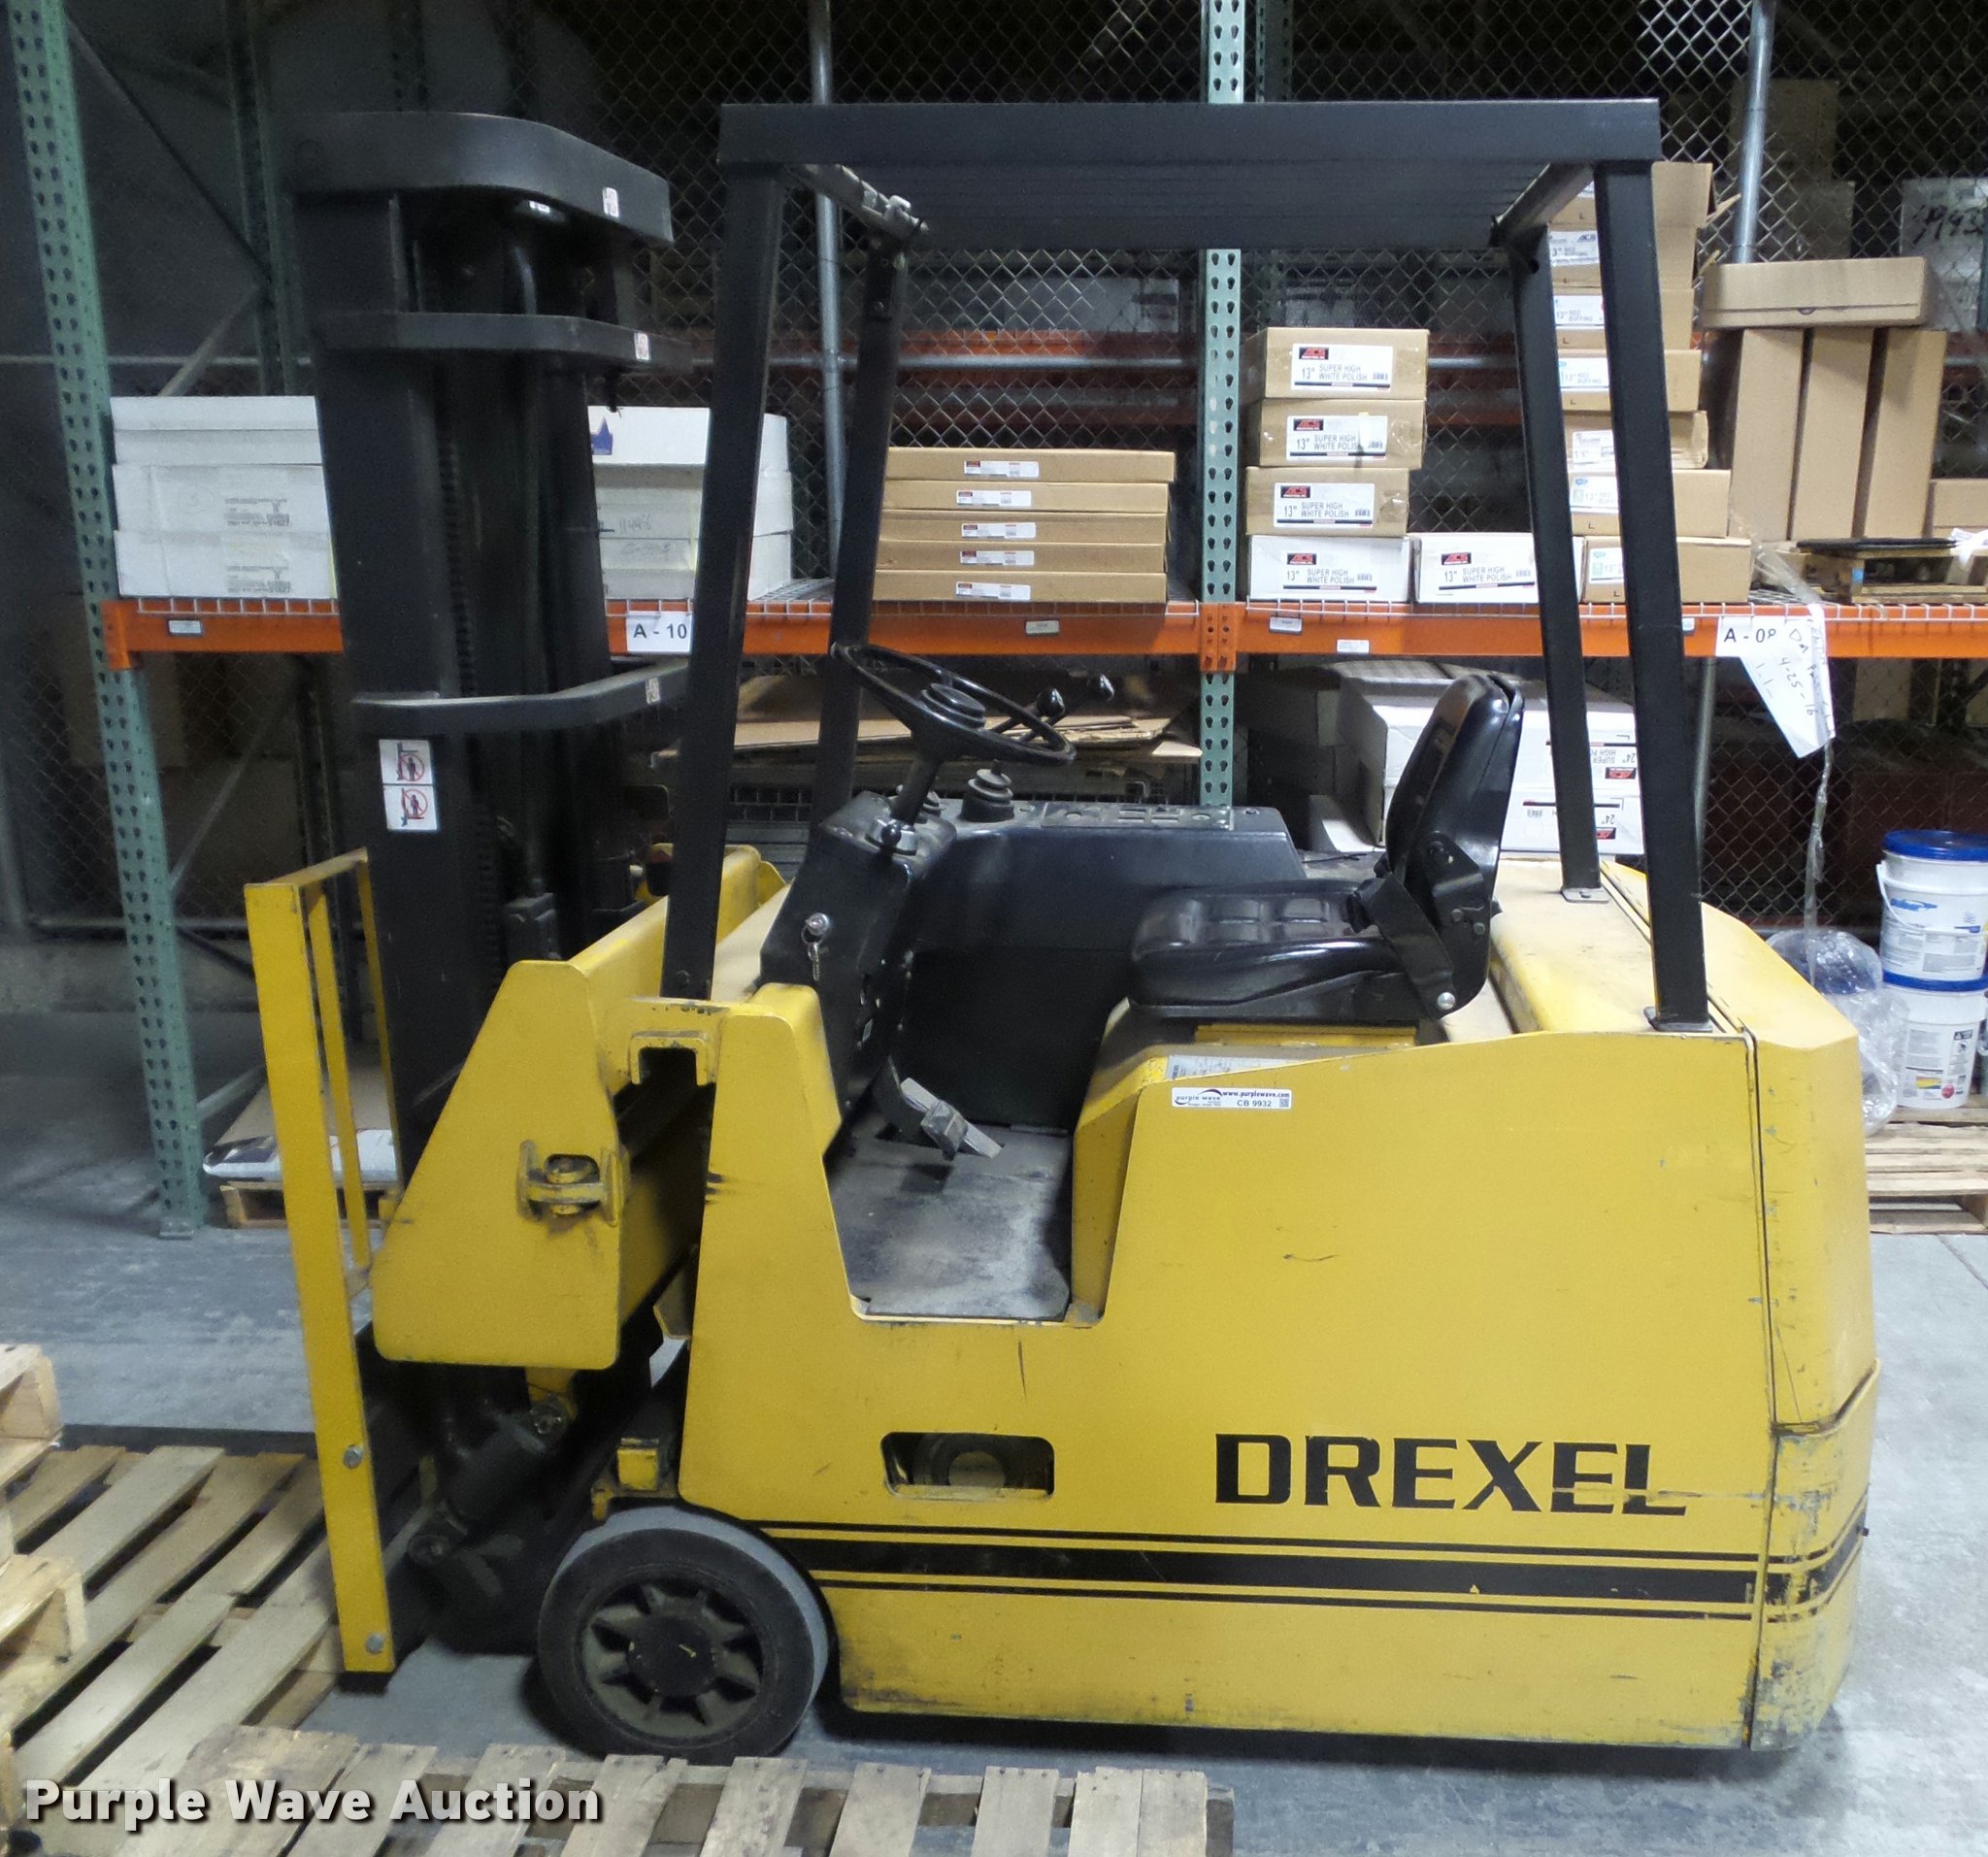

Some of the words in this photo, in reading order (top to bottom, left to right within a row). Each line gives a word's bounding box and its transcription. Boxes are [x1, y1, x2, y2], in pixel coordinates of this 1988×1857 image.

[1302, 367, 1315, 380] 13"
[1297, 438, 1310, 450] 13"
[1284, 505, 1297, 517] 13"
[1287, 570, 1300, 581] 13"
[1444, 570, 1457, 582] 13"
[1463, 567, 1486, 576] SUPER
[1486, 573, 1512, 581] POLISH
[634, 624, 647, 639] A
[666, 624, 687, 639] 10
[1724, 627, 1737, 643] A
[1601, 814, 1615, 825] 24"
[1215, 1433, 1687, 1515] DREXEL
